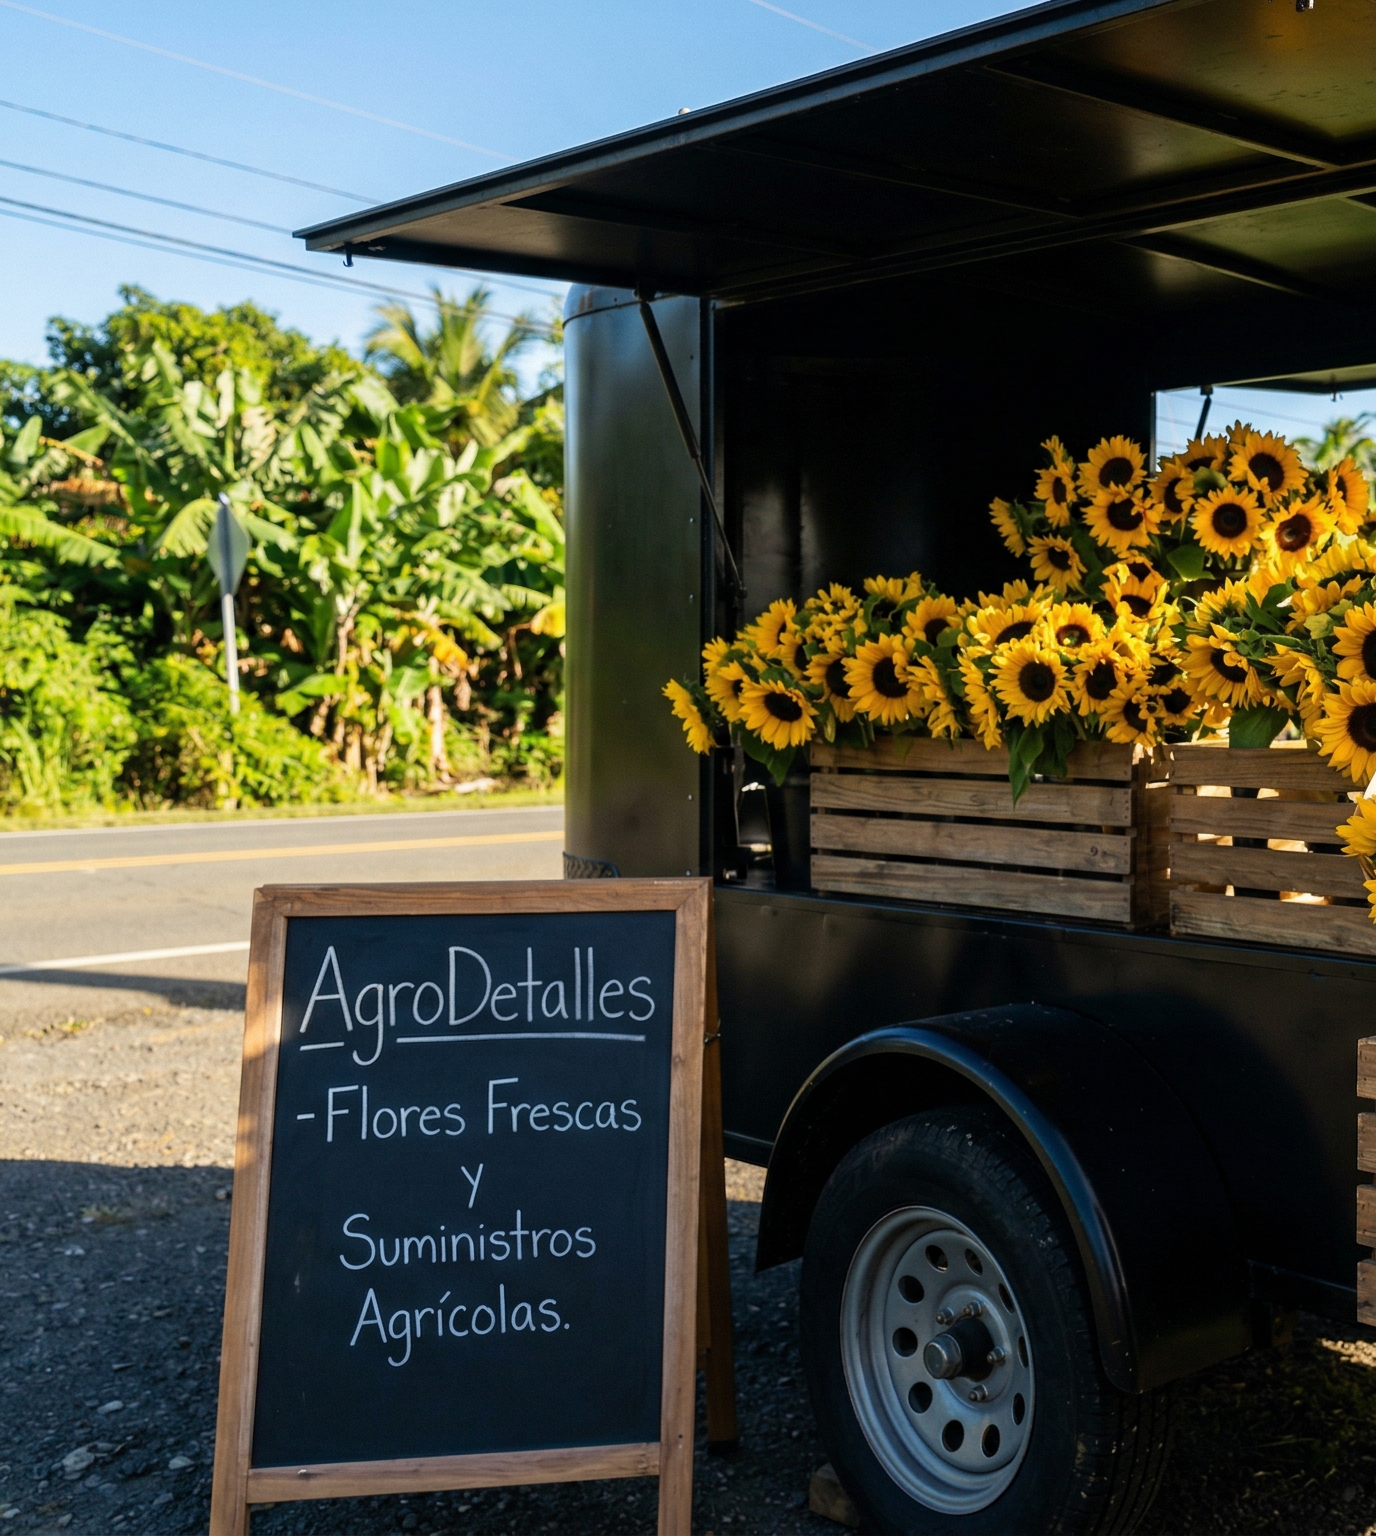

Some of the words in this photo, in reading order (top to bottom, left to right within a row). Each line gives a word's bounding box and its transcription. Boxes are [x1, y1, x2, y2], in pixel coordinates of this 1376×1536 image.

[299, 945, 656, 1066] AgroDetalles
[487, 1077, 642, 1134] Frescas
[339, 1209, 597, 1271] Suministros
[350, 1283, 570, 1367] Agrícolas.
